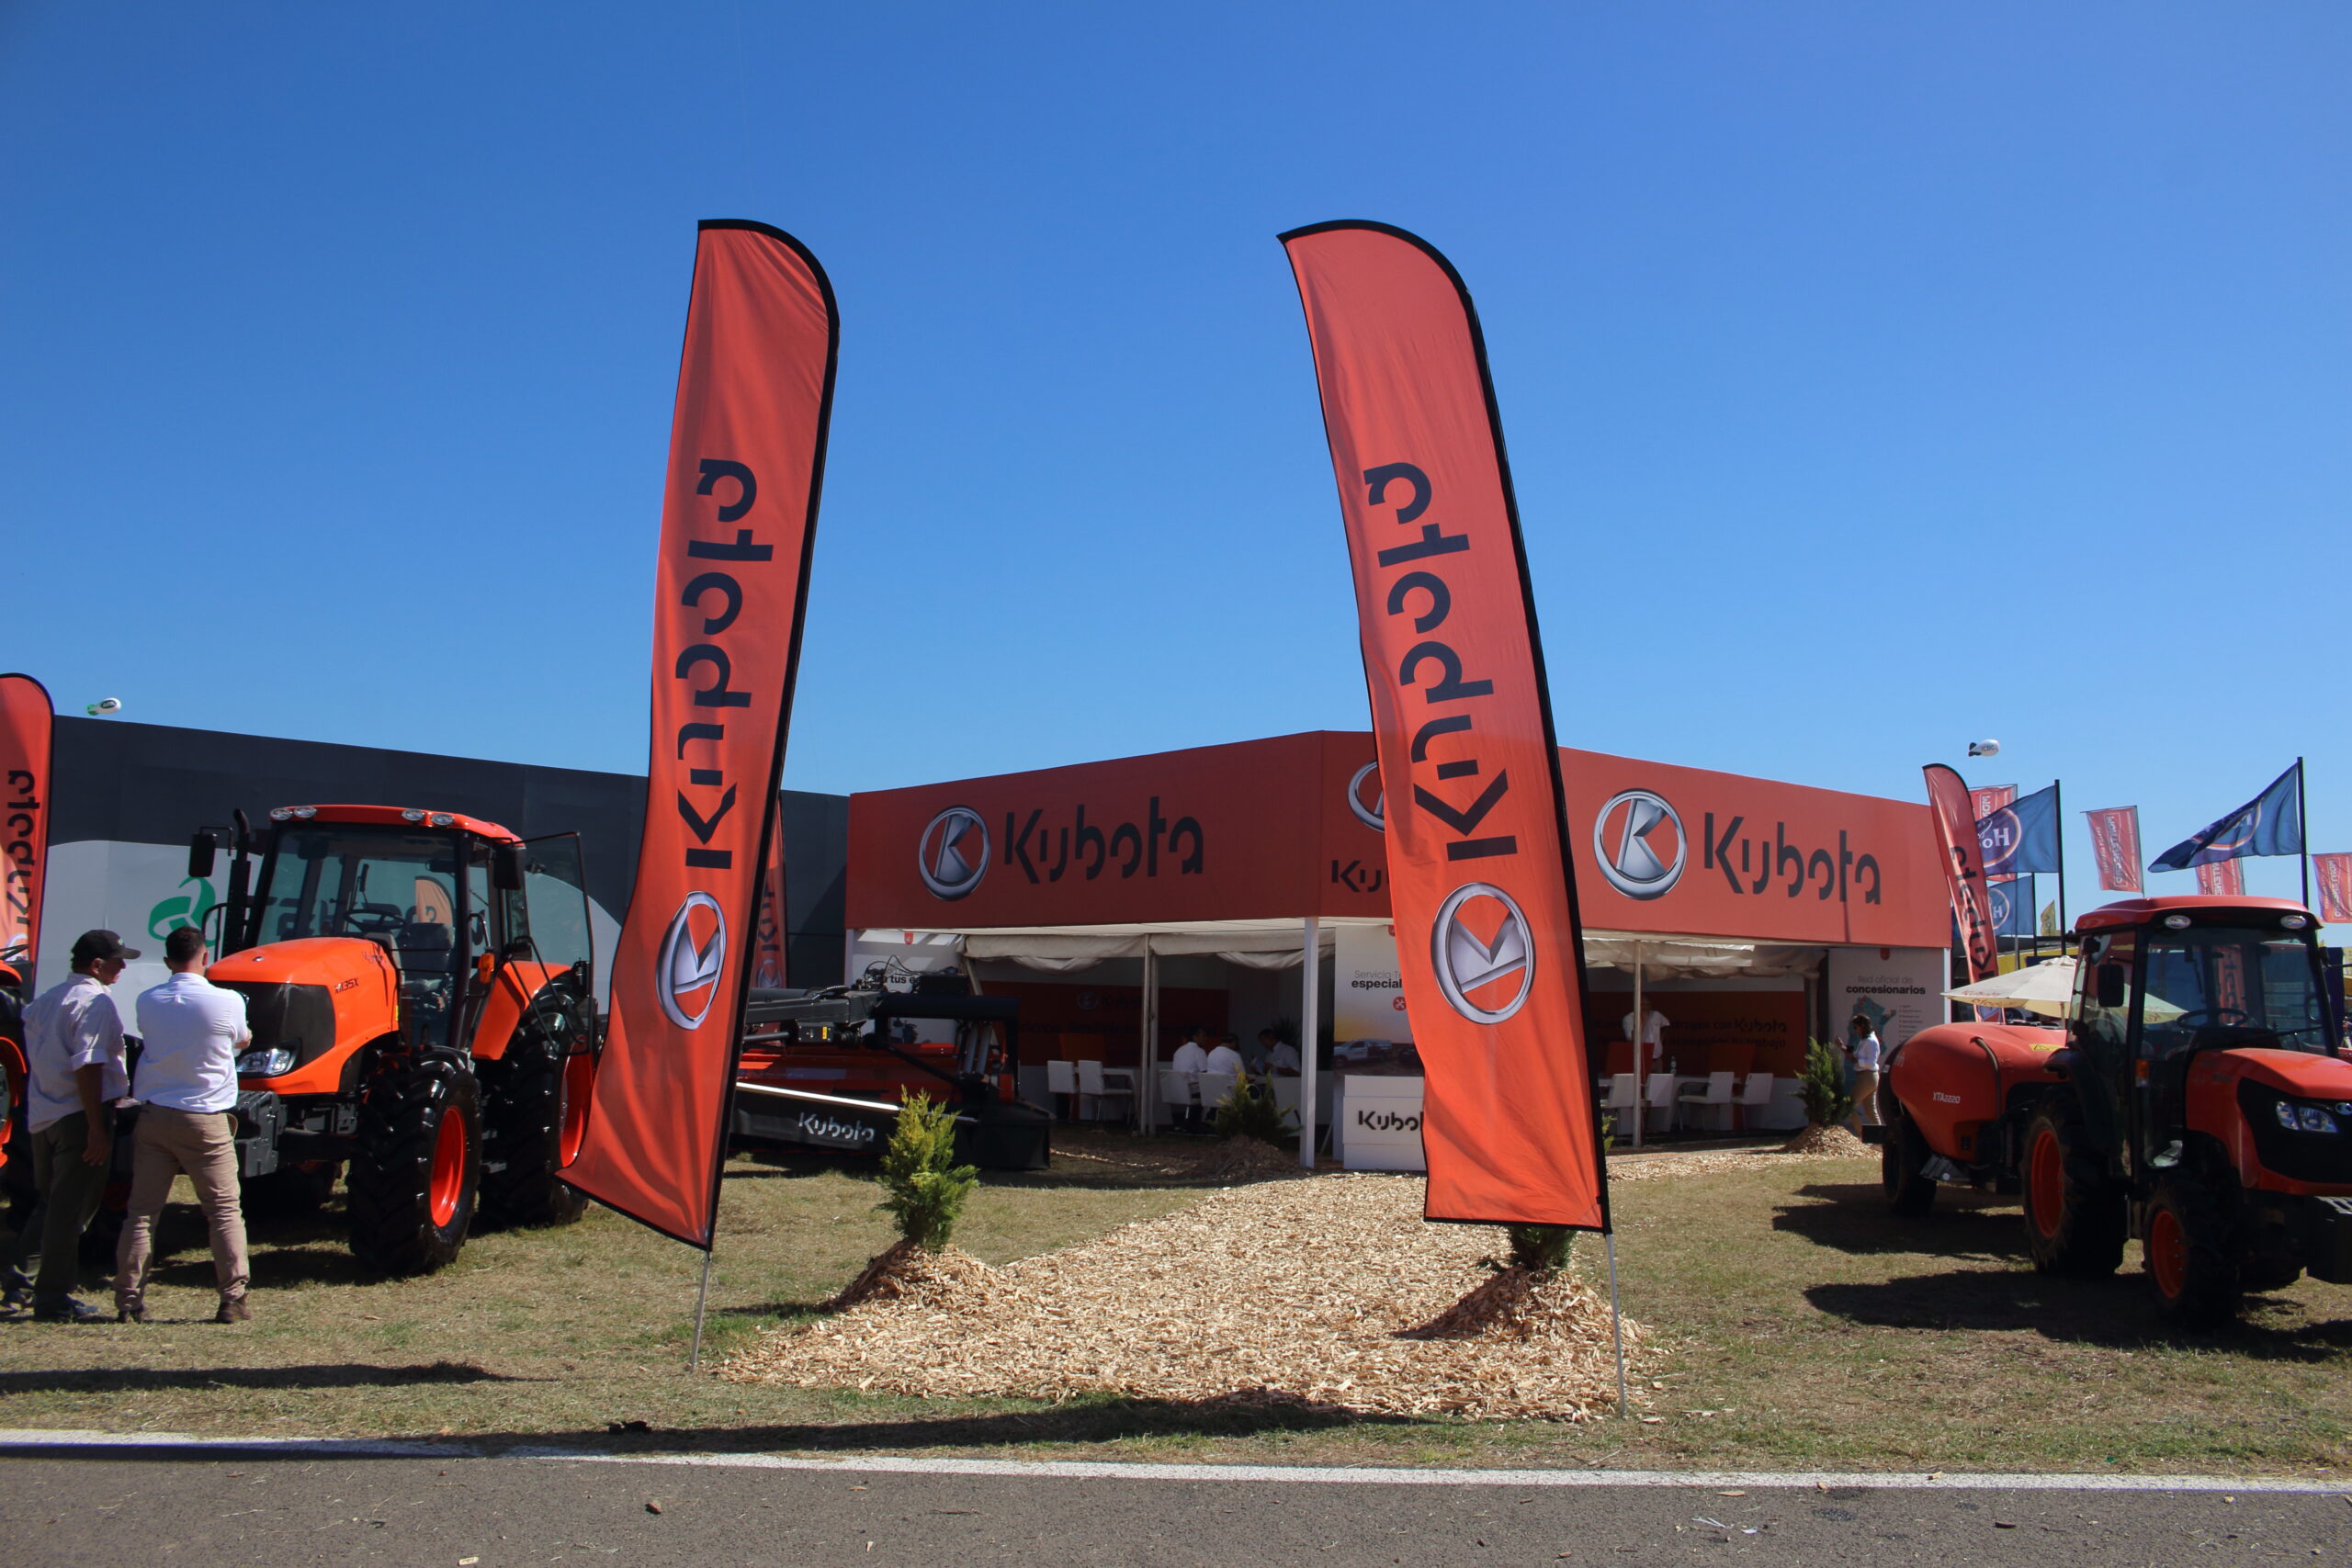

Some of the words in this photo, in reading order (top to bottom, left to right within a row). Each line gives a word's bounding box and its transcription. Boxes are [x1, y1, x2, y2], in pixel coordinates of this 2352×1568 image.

[1003, 795, 1204, 886] Kubota
[1703, 812, 1882, 905] Kubota
[1351, 978, 1402, 990] especial
[1846, 985, 1926, 995] concesionarios
[797, 1111, 876, 1143] Kubota
[1358, 1110, 1423, 1132] Kubo
